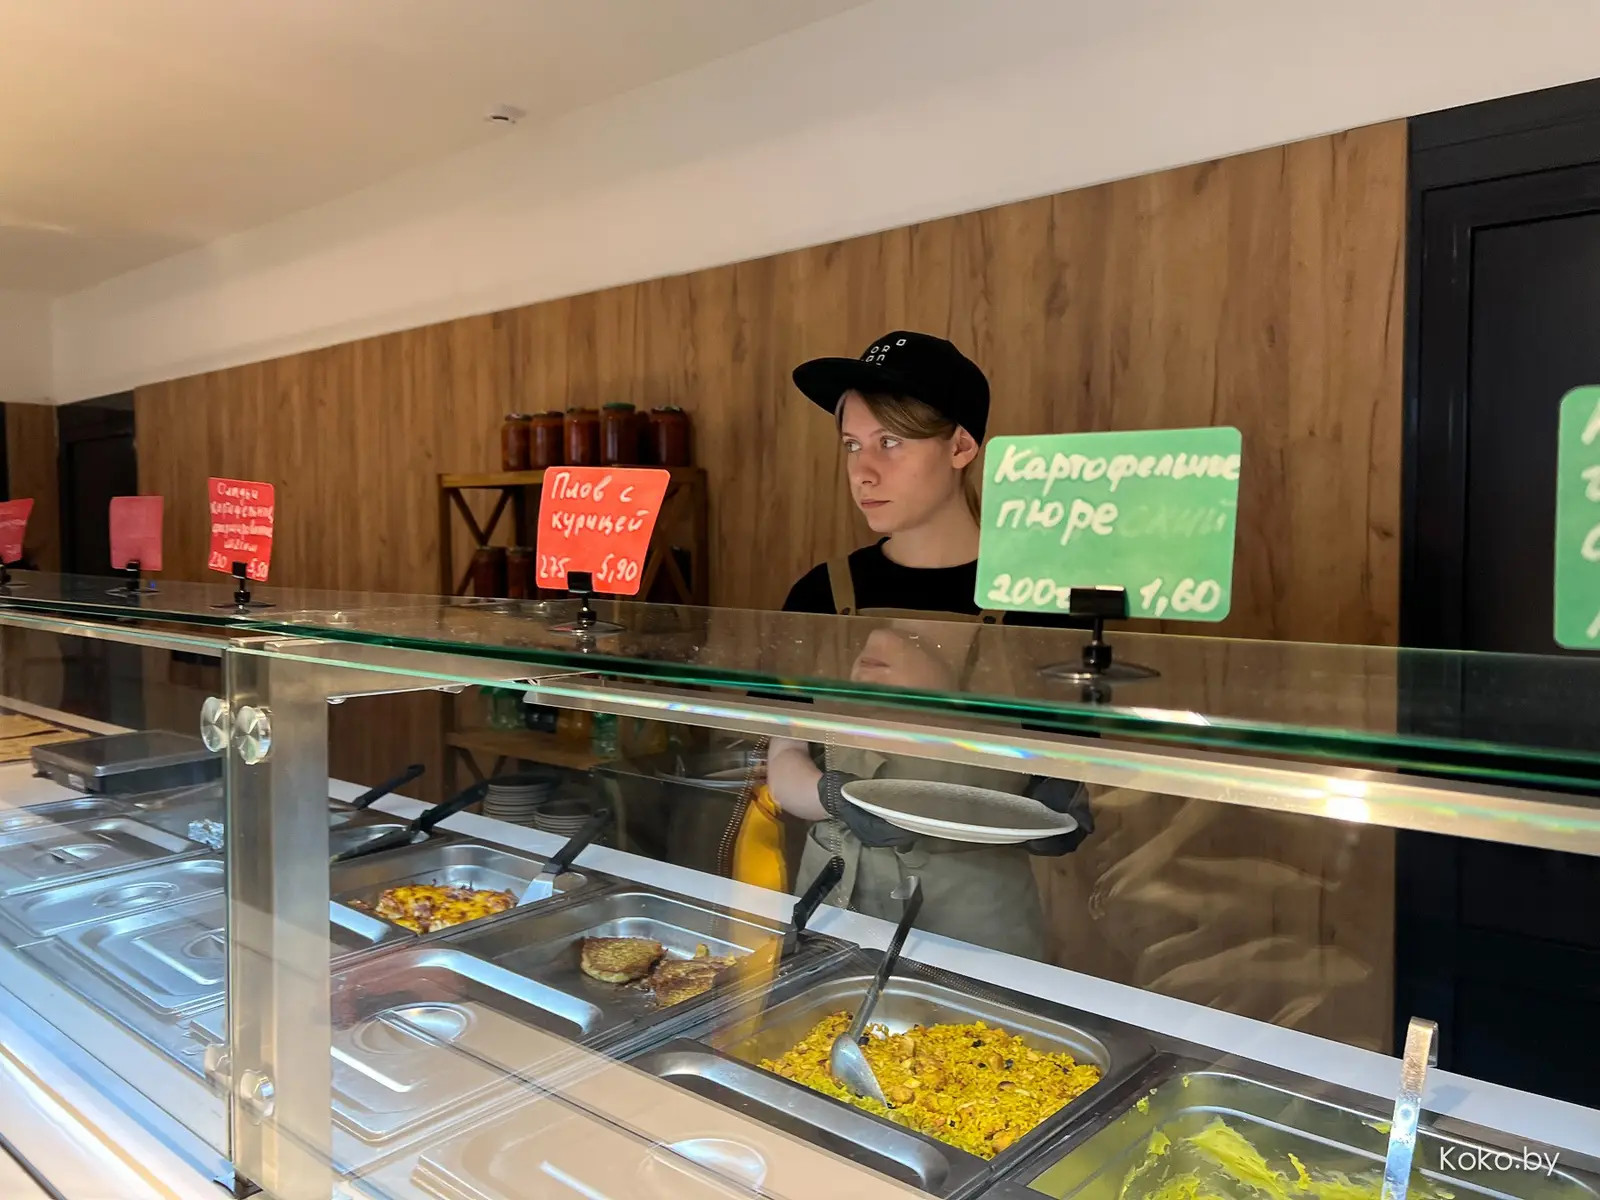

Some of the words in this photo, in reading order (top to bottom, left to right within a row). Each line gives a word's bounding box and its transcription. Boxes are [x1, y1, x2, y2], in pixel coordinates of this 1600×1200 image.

[551, 472, 612, 502] Плов
[619, 486, 635, 502] с
[551, 510, 650, 538] курицей
[996, 498, 1119, 546] пюре
[596, 553, 639, 583] 5,90
[1138, 577, 1221, 617] 1,60
